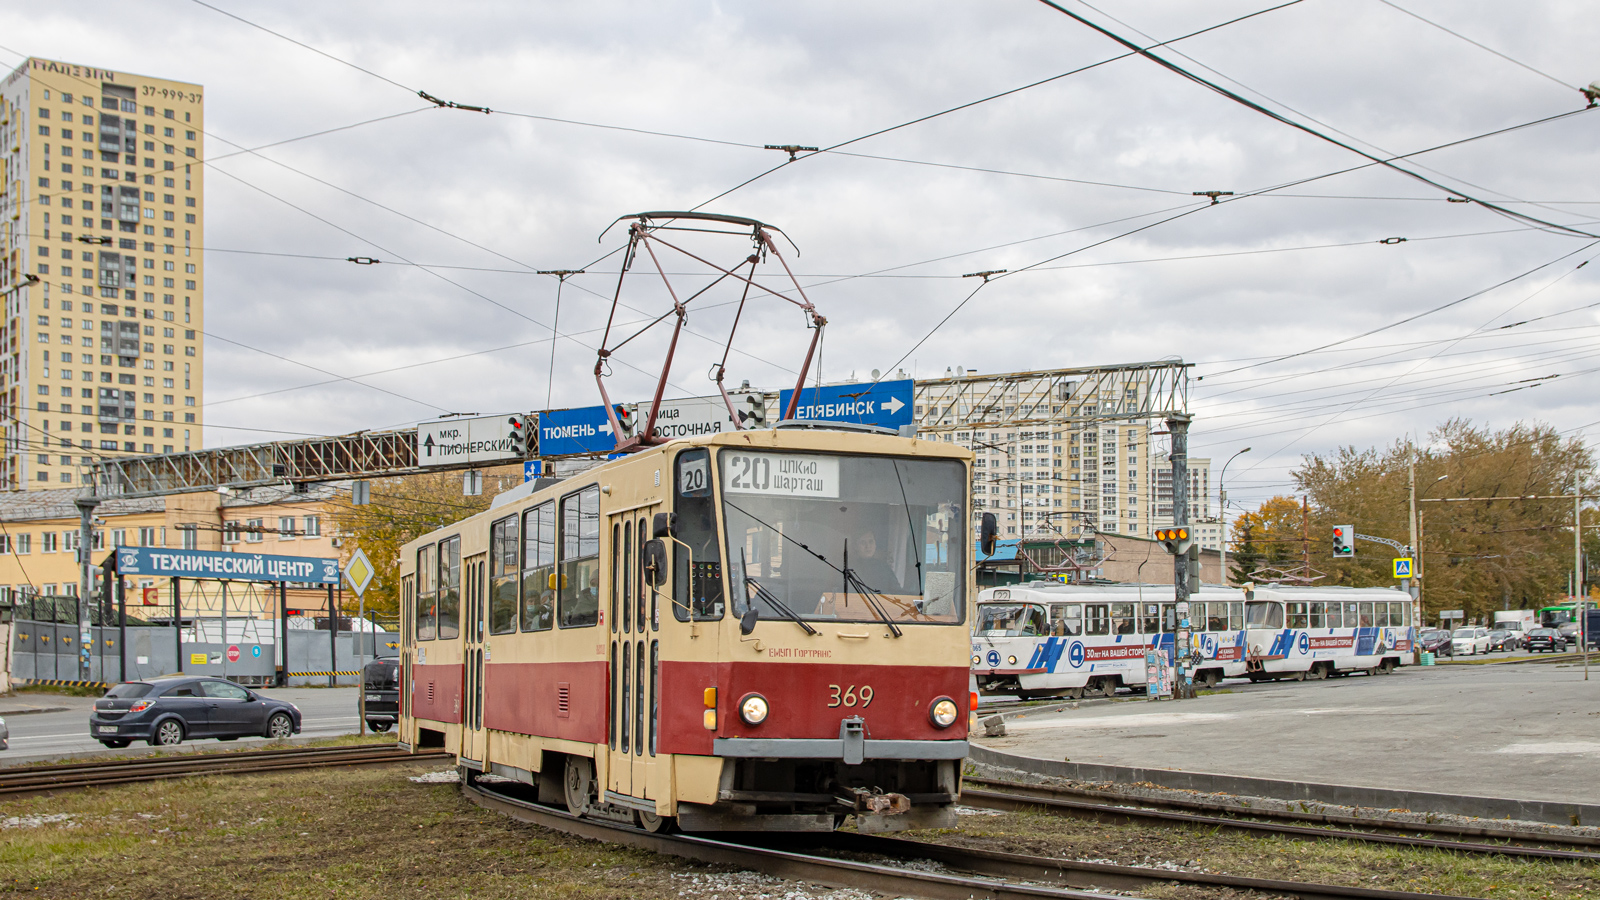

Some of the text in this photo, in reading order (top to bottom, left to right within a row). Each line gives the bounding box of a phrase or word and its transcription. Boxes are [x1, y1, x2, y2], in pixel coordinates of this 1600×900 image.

[142, 85, 203, 104] 37-999-37
[645, 408, 680, 423] ица
[794, 400, 875, 419] ЕЛЯБИНСК
[440, 429, 462, 440] мкр.
[543, 423, 596, 440] ТЮМЕНЬ
[655, 421, 721, 438] ОСТОЧНАЯ
[731, 456, 770, 490] 20
[779, 459, 817, 475] ЦПКиО
[685, 469, 703, 490] 20
[773, 475, 824, 492] Шарташ
[149, 553, 314, 579] ТЕХНИЧЕСКИЙ ЦЕНТР
[768, 648, 791, 657] ЕМУП
[1101, 650, 1109, 658] НА
[1110, 647, 1127, 657] ВАШЕЙ
[1128, 648, 1150, 656] СТОРО
[827, 684, 874, 708] 369
